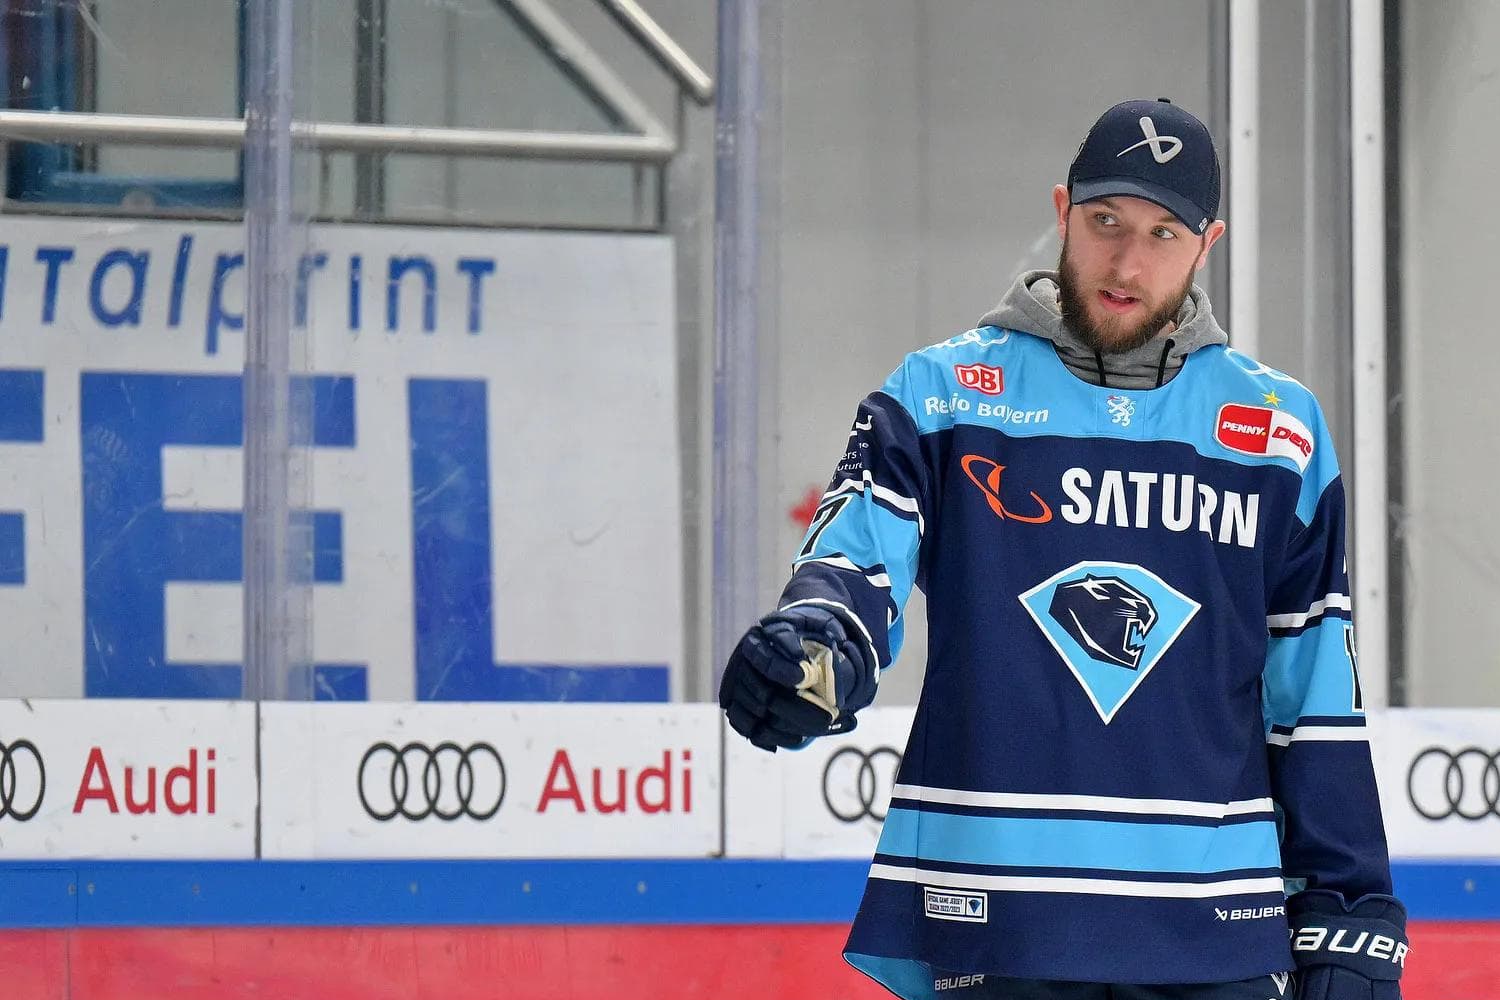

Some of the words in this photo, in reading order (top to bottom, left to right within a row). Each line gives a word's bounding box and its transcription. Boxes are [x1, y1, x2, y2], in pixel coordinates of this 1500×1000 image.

[960, 368, 998, 391] DB
[977, 402, 1050, 424] Bayern
[1061, 467, 1260, 548] SATURN
[73, 747, 217, 815] Audi
[537, 749, 693, 814] Audi
[1289, 927, 1414, 969] AUER
